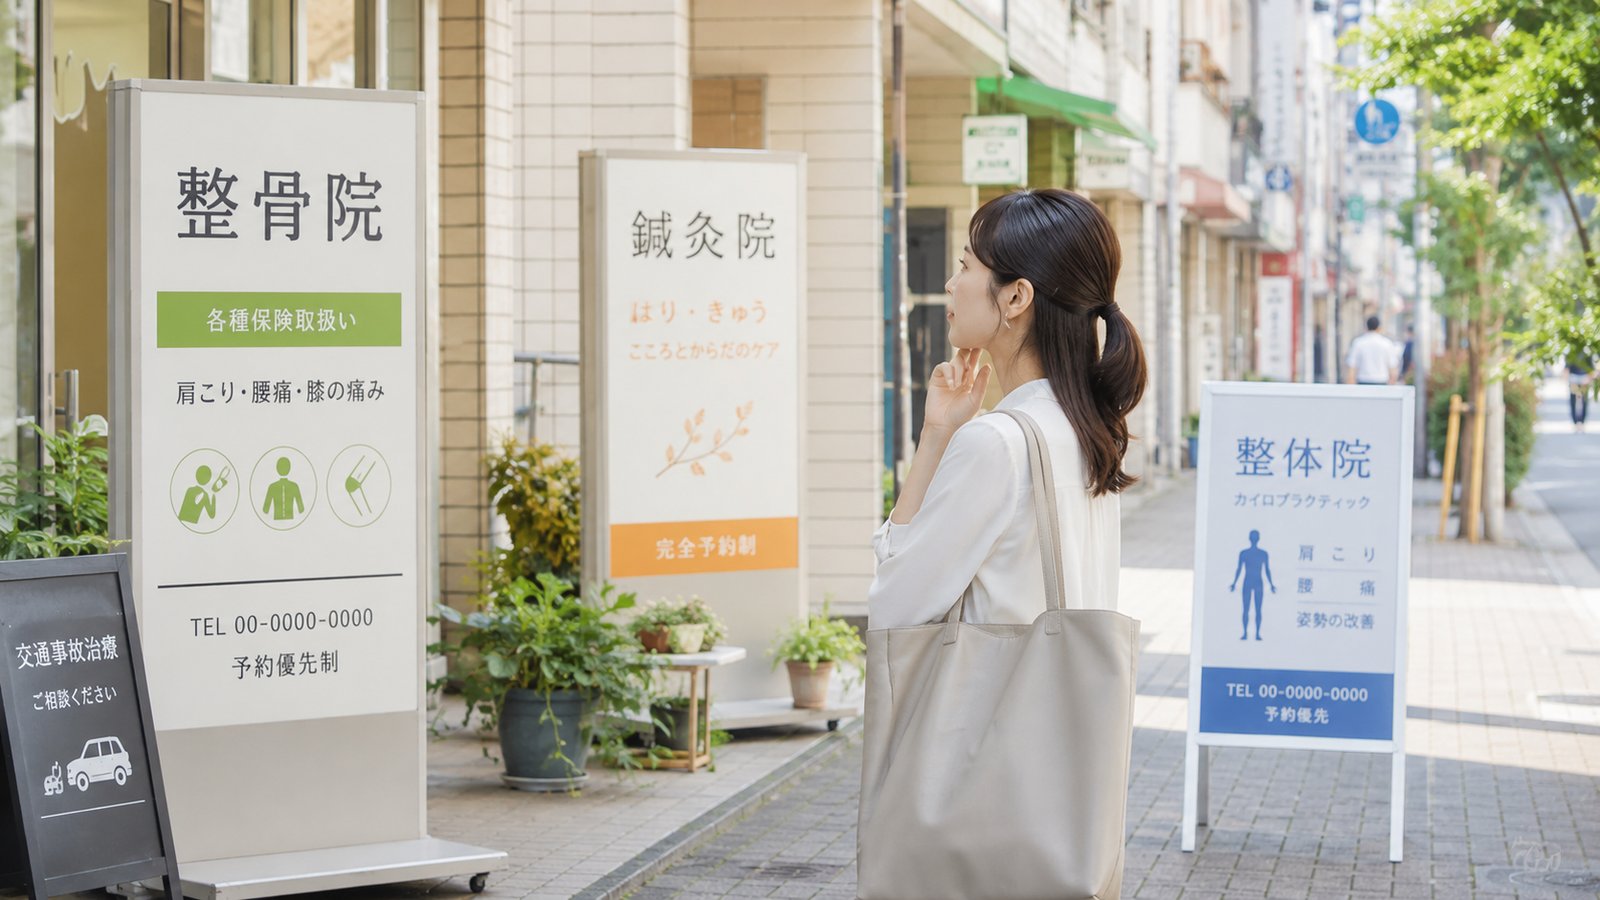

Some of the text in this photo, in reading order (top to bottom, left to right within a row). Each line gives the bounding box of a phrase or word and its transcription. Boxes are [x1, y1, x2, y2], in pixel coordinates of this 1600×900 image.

[177, 166, 384, 242] 整骨院
[632, 210, 776, 260] 鍼灸院
[206, 307, 357, 333] 各種保険取扱い
[628, 340, 780, 361] こころとからだのケア
[176, 379, 385, 406] 肩こり・腰痛・膝の痛み
[1236, 436, 1371, 479] 整体院
[656, 533, 757, 560] 完全予約制
[191, 607, 374, 638] TEL 00-0000-0000
[1297, 612, 1375, 630] 姿勢の改善
[15, 633, 119, 670] 交通事故治療
[232, 650, 338, 680] 予約優先制
[32, 685, 117, 711] ご相談ください
[1226, 682, 1369, 703] TEL 00-0000-0000
[1264, 705, 1330, 725] 予約優先
